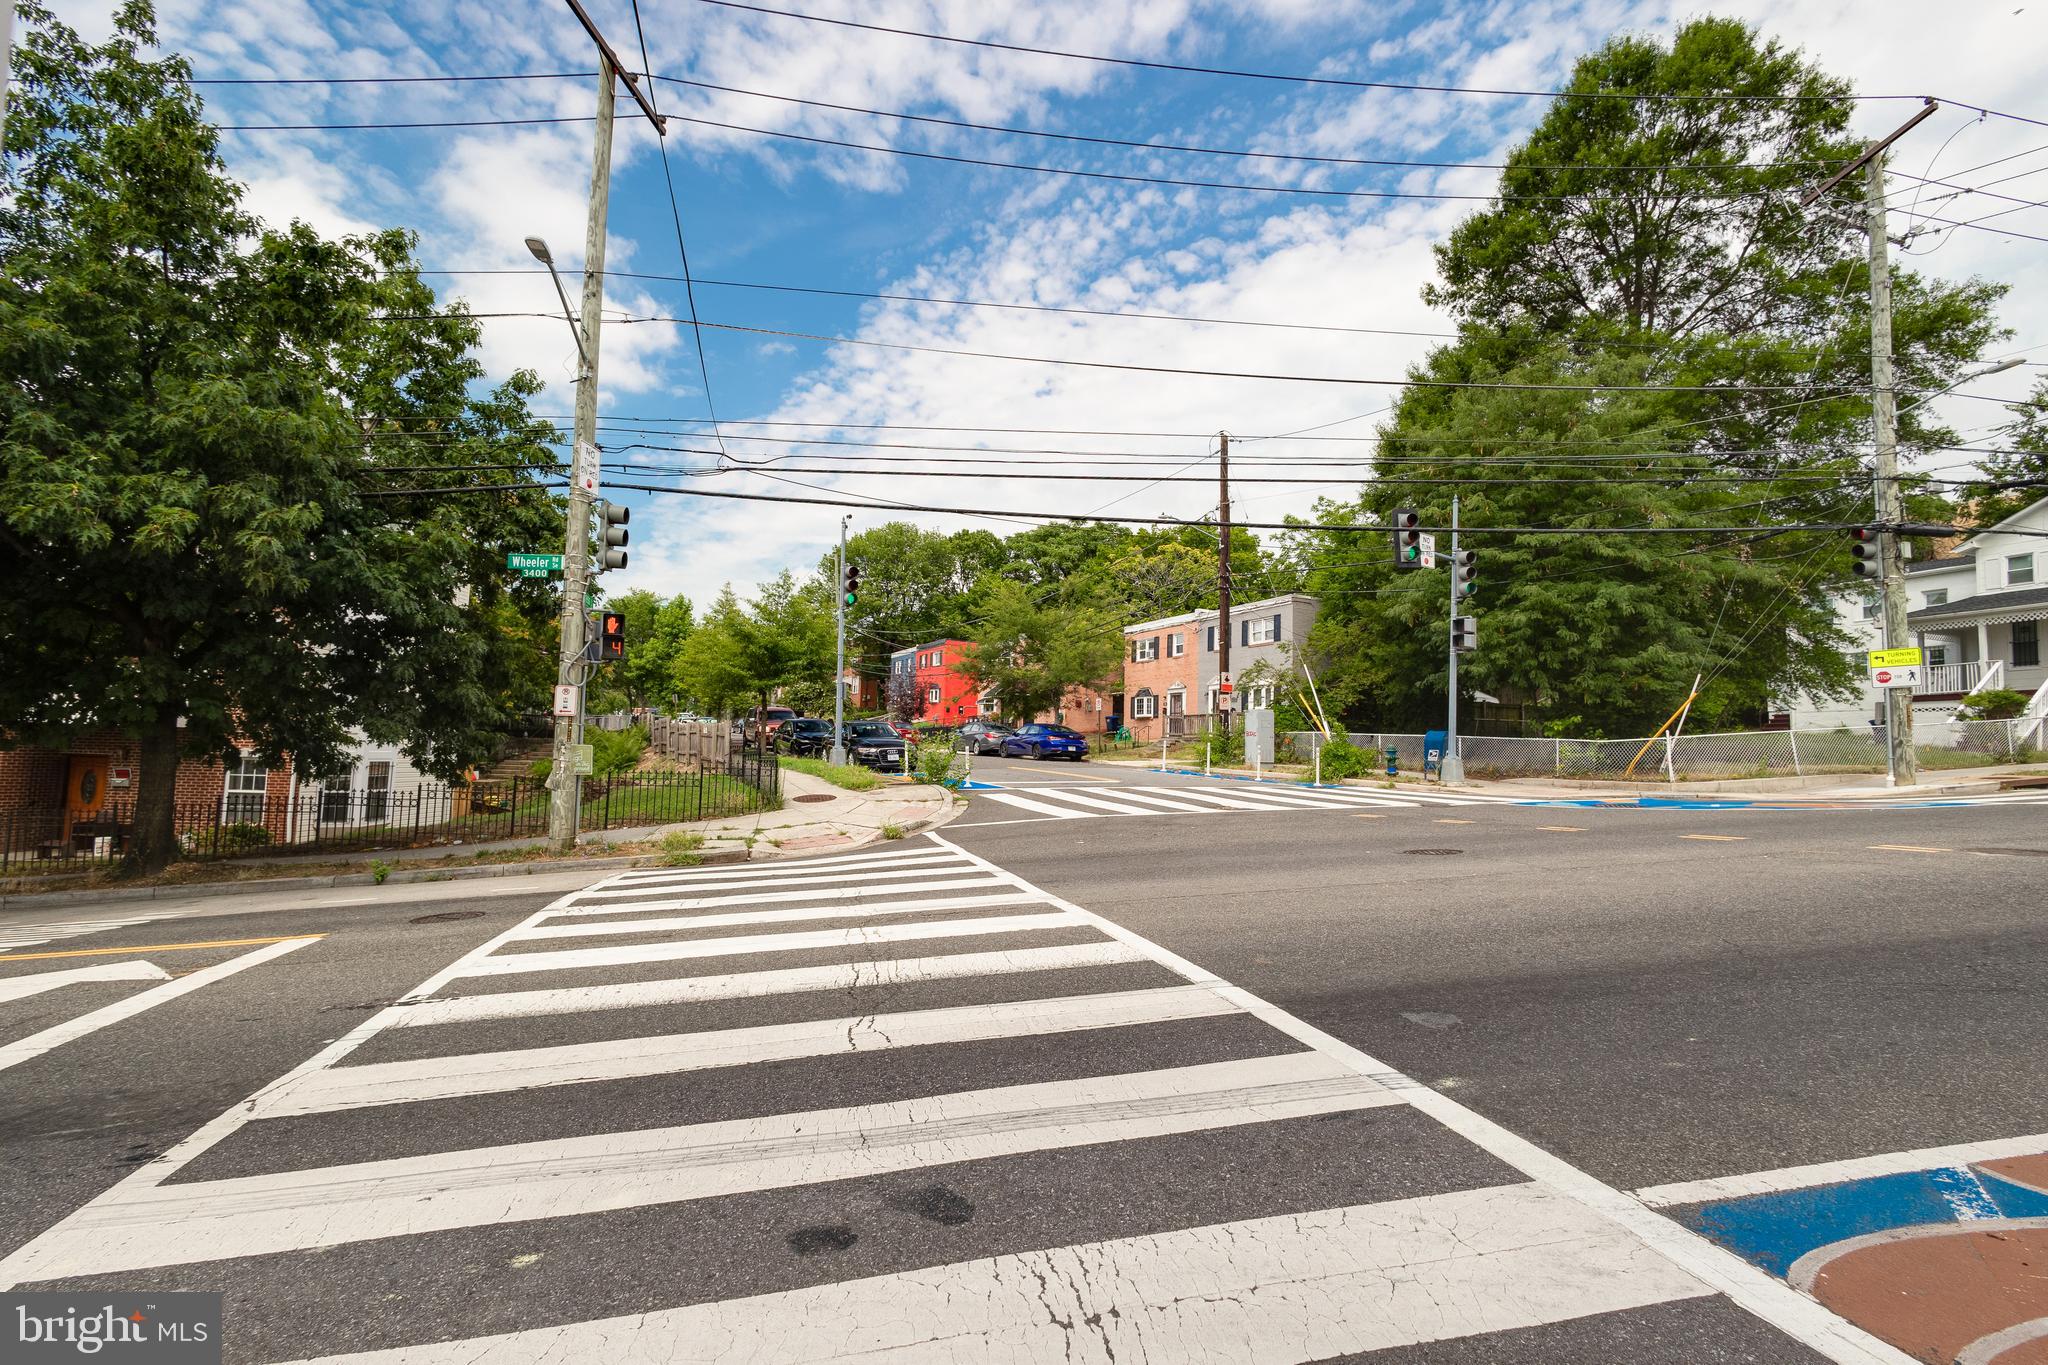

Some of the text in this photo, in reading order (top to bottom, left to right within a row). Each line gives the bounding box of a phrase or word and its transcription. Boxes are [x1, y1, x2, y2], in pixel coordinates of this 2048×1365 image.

[585, 447, 596, 460] NO
[512, 556, 549, 568] Wheeler
[523, 569, 547, 577] 3400
